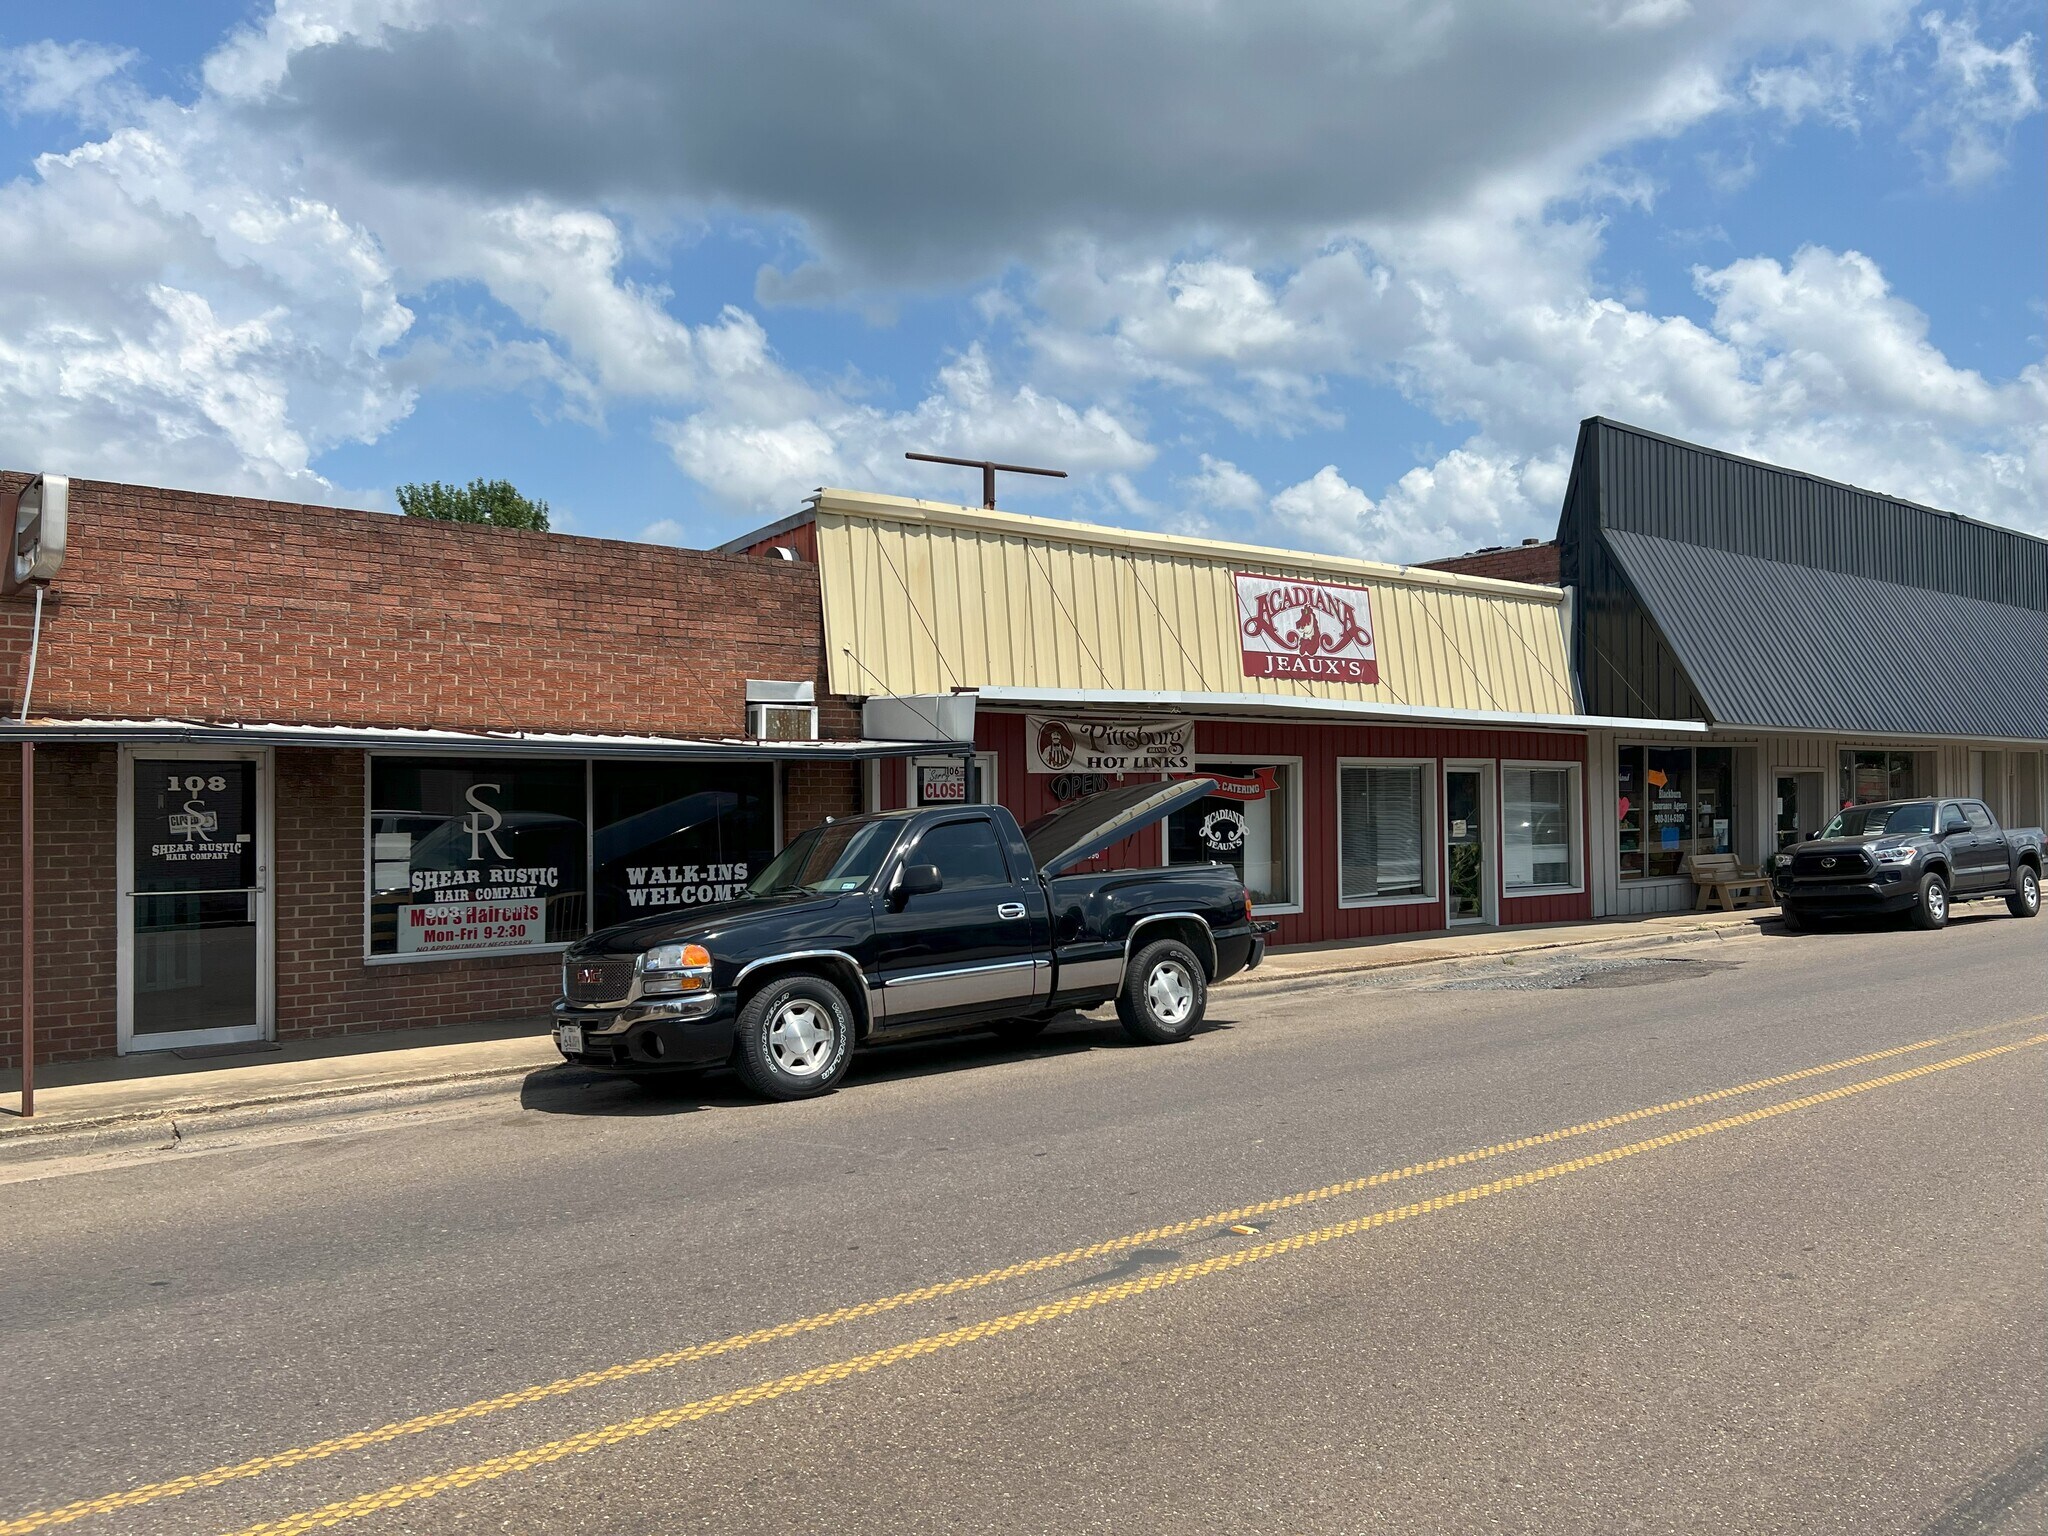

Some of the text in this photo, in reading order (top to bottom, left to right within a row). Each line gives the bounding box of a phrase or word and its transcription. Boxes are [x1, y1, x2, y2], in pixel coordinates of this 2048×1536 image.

[1248, 585, 1363, 645] ACADIANA
[1264, 655, 1361, 676] JEAUX'S
[1080, 724, 1184, 755] Pittsburg
[1087, 757, 1188, 769] HOT LINKS
[167, 776, 227, 791] 108
[925, 783, 964, 798] CLOSE
[1057, 773, 1106, 800] OPEN
[1222, 782, 1260, 794] CATERING
[1202, 809, 1246, 834] ACADIANA
[152, 843, 242, 857] SHEAR RUSTIC
[1206, 839, 1243, 851] JEAUX'S
[166, 852, 229, 861] HAIR COMPANY
[411, 867, 558, 893] SHEAR RUSTIC
[626, 863, 748, 885] WALK-INS
[434, 885, 537, 902] HAIR COMPANY
[424, 924, 526, 943] Mon-Fri 9-2:30
[431, 941, 486, 951] APPOINTMENT
[487, 939, 533, 947] NECESSARY
